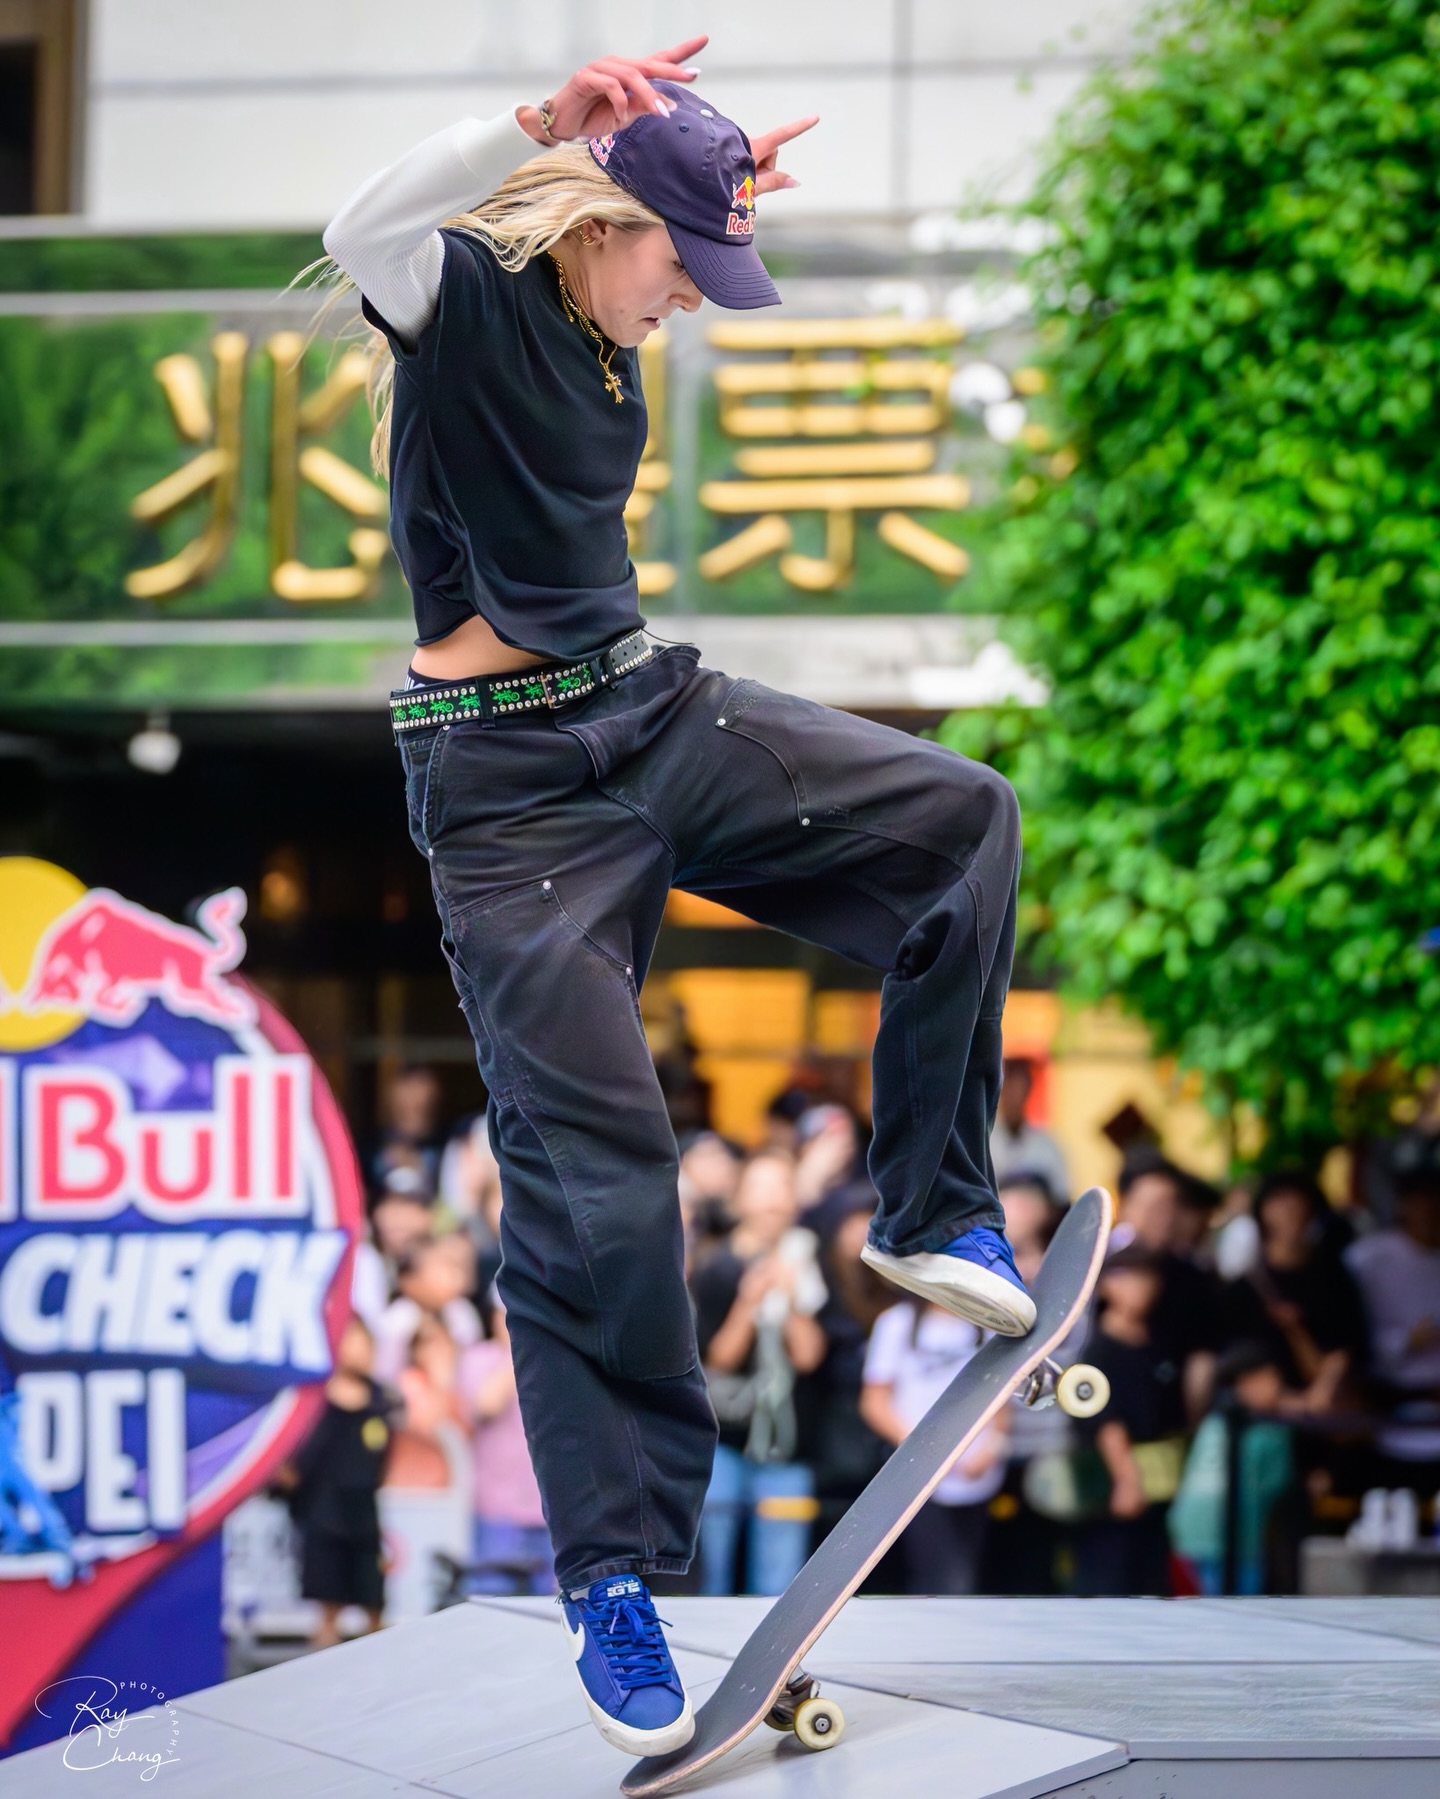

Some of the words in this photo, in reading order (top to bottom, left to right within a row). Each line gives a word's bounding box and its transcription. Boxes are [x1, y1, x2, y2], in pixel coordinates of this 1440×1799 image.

[727, 212, 750, 234] Red
[34, 1066, 302, 1212] Bull
[2, 1230, 348, 1374] CHECK
